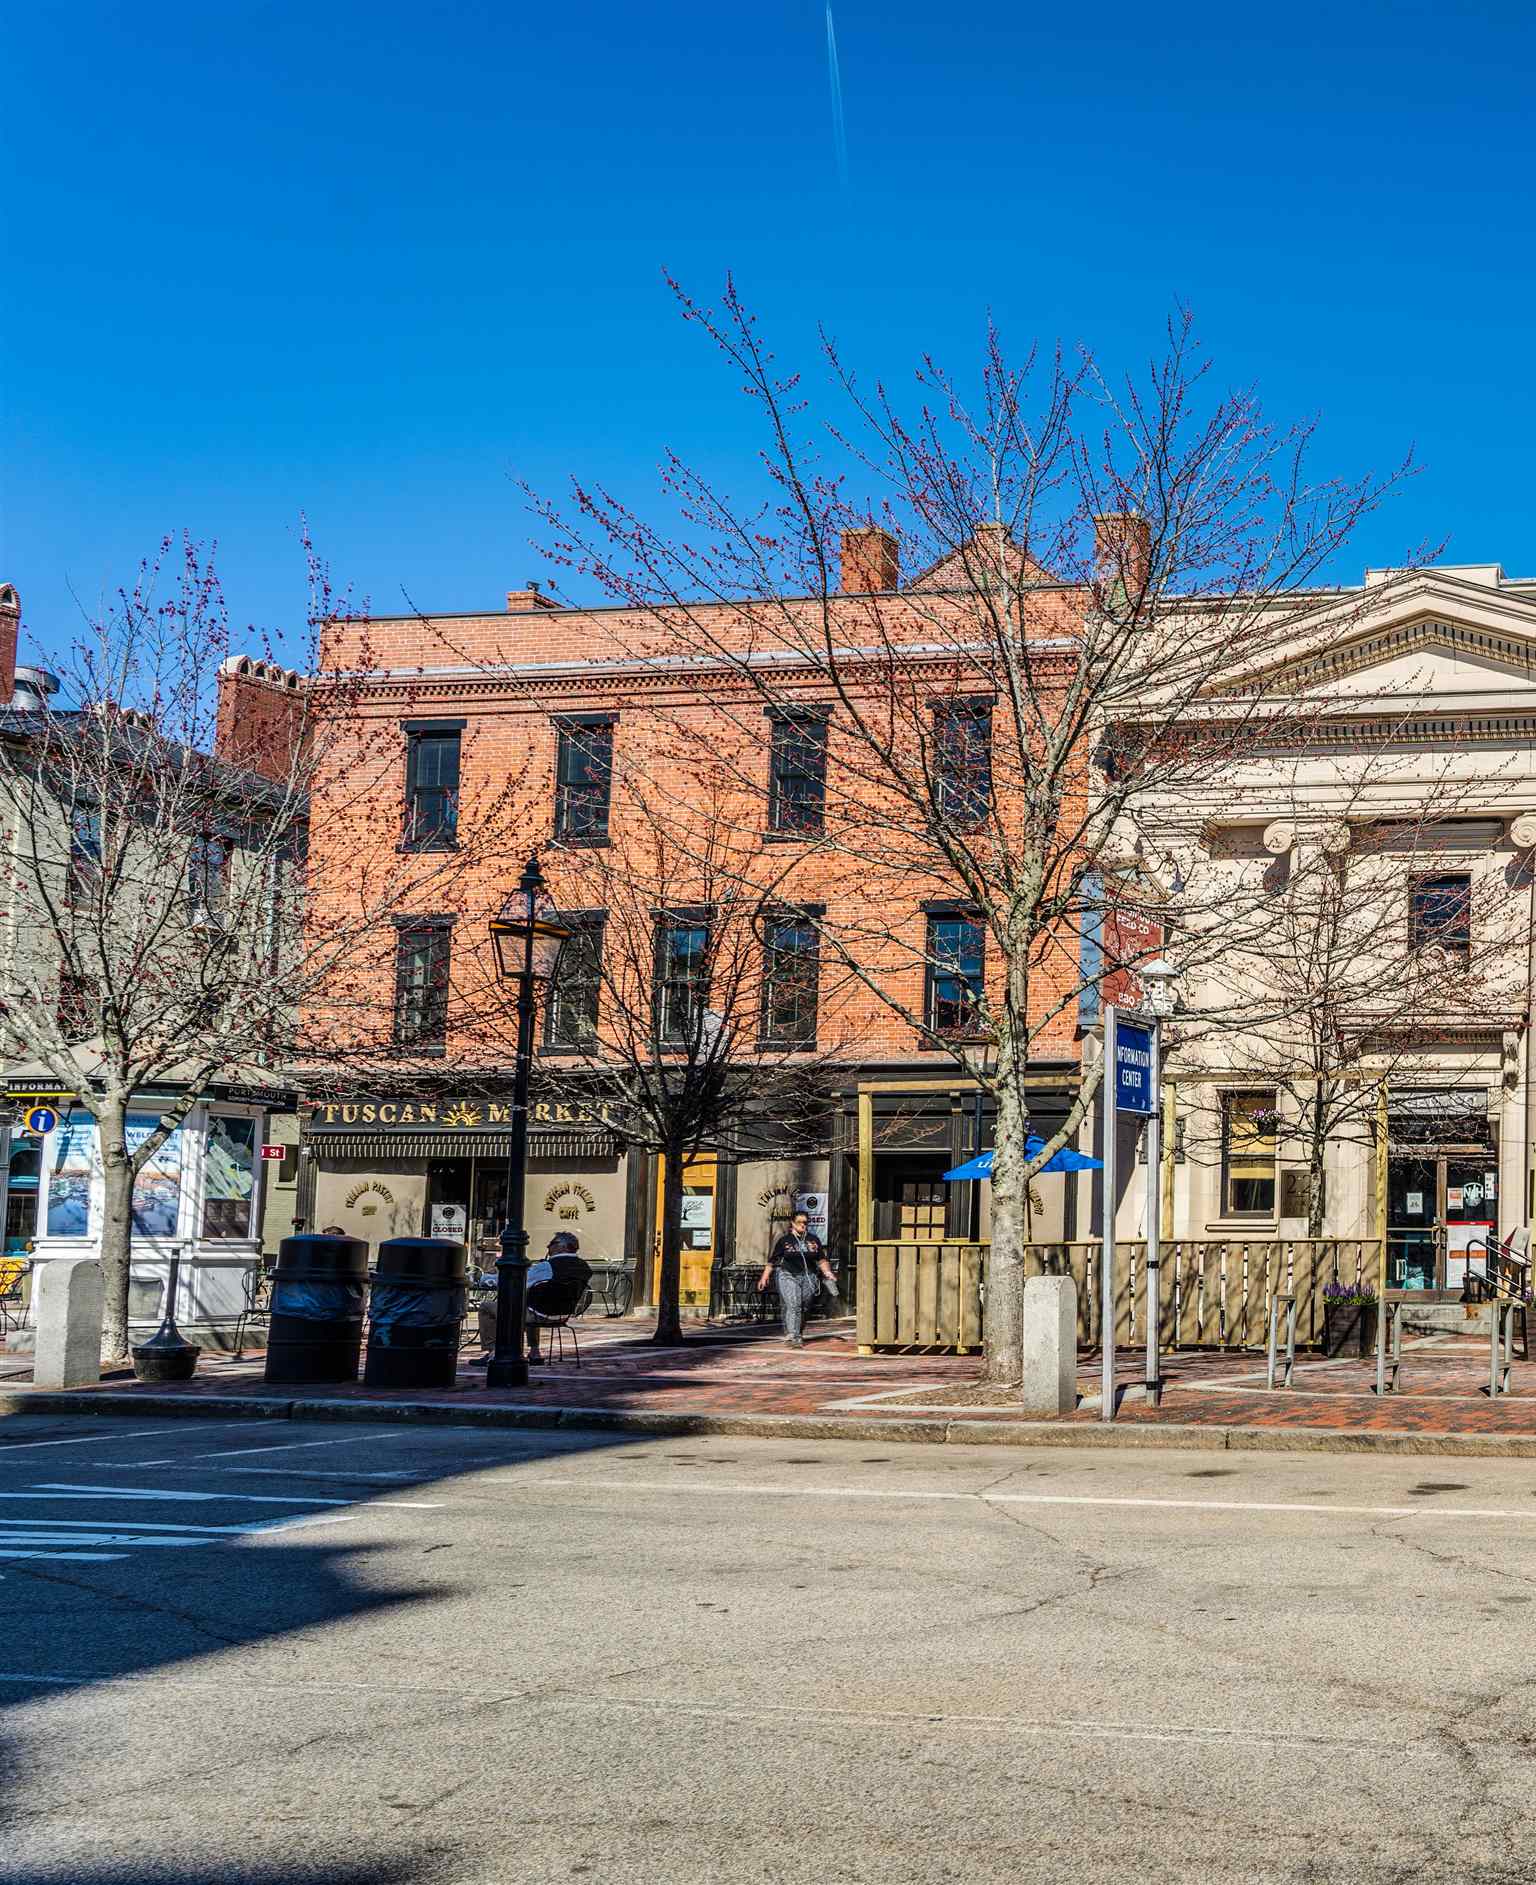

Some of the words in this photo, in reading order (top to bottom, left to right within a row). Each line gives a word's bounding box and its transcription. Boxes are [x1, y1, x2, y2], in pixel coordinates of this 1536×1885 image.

[1117, 1046, 1149, 1067] NFORMATION
[9, 1082, 67, 1091] INFORMAT
[1121, 1070, 1142, 1088] CENTER
[322, 1103, 438, 1124] TUSCAN
[487, 1103, 617, 1122] MRKET
[270, 1149, 280, 1157] St
